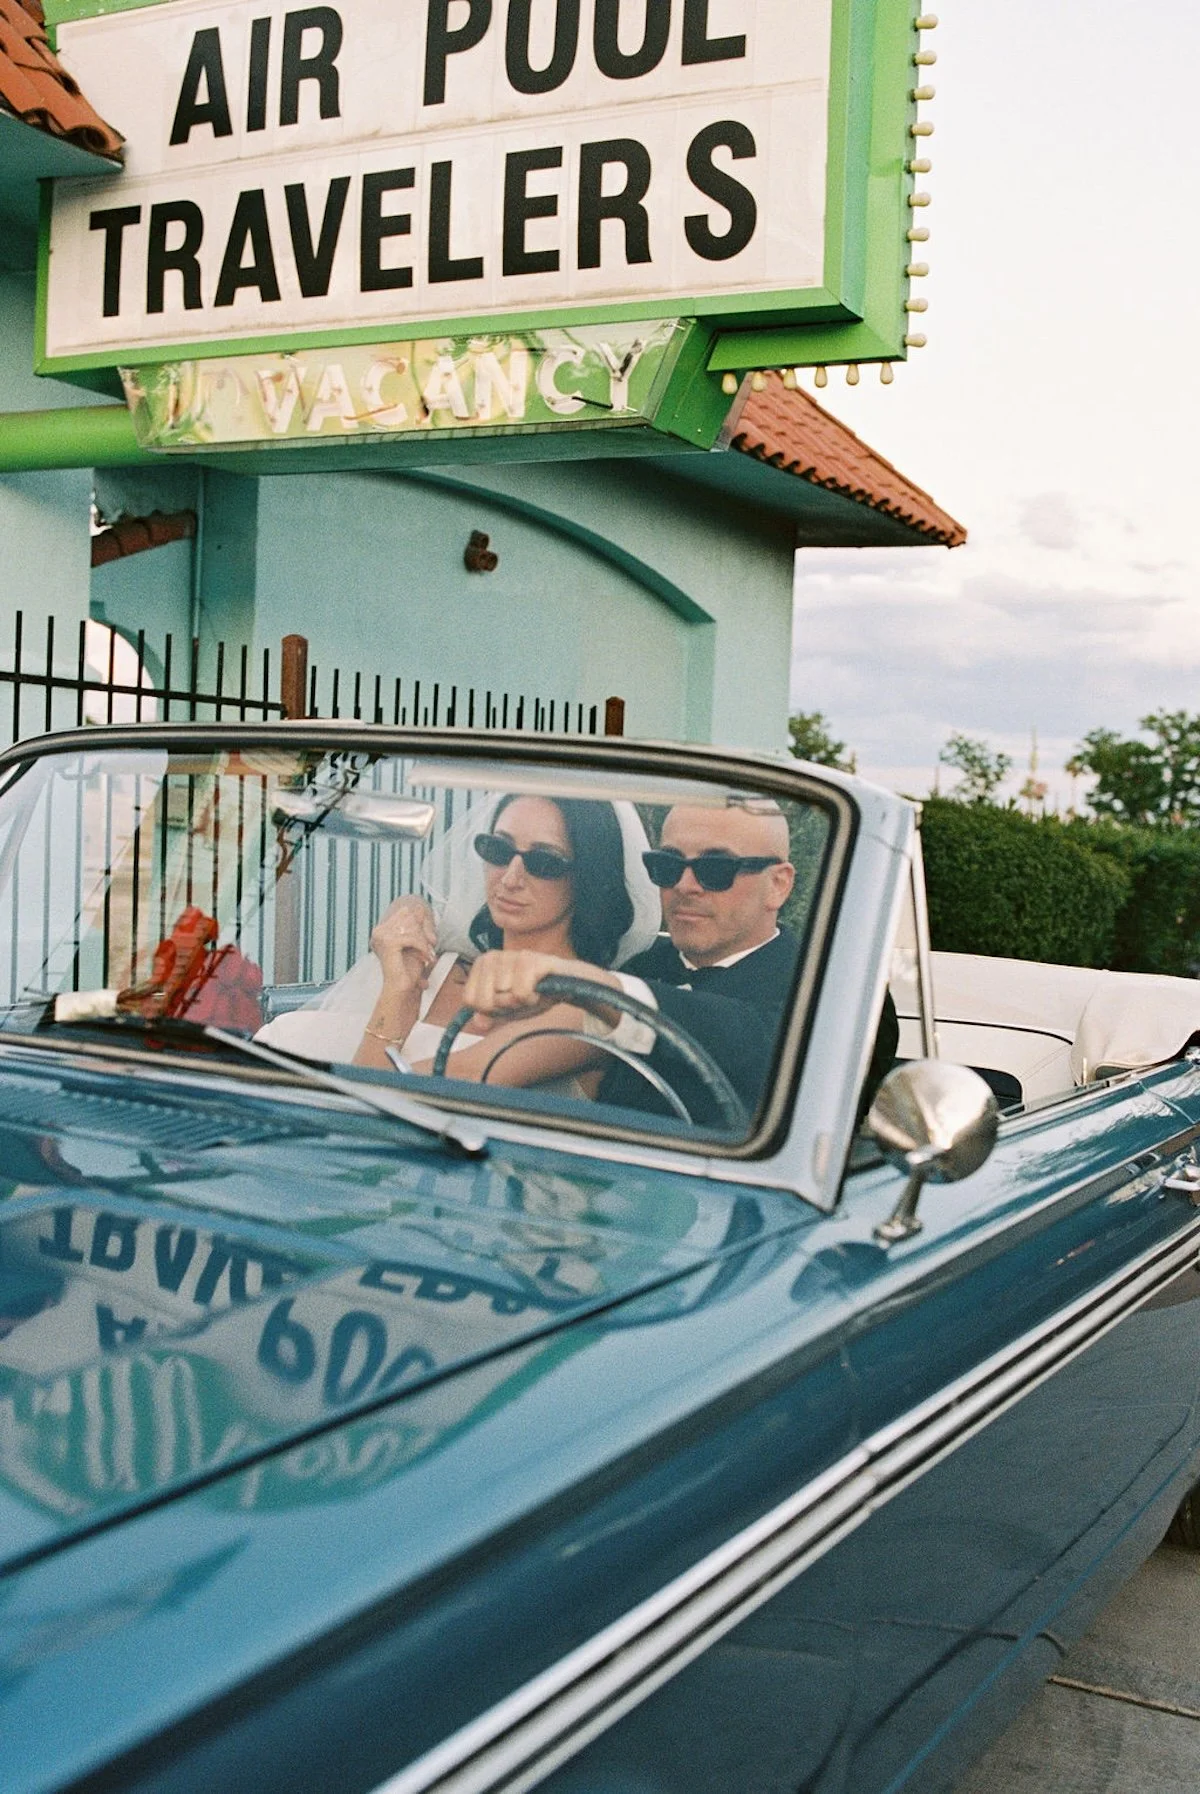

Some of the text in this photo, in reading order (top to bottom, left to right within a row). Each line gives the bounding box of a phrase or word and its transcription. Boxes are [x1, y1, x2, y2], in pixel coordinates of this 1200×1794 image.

[170, 0, 746, 146] AIR POOL
[89, 121, 757, 317] TRAVELERS
[257, 339, 648, 433] VACANCY
